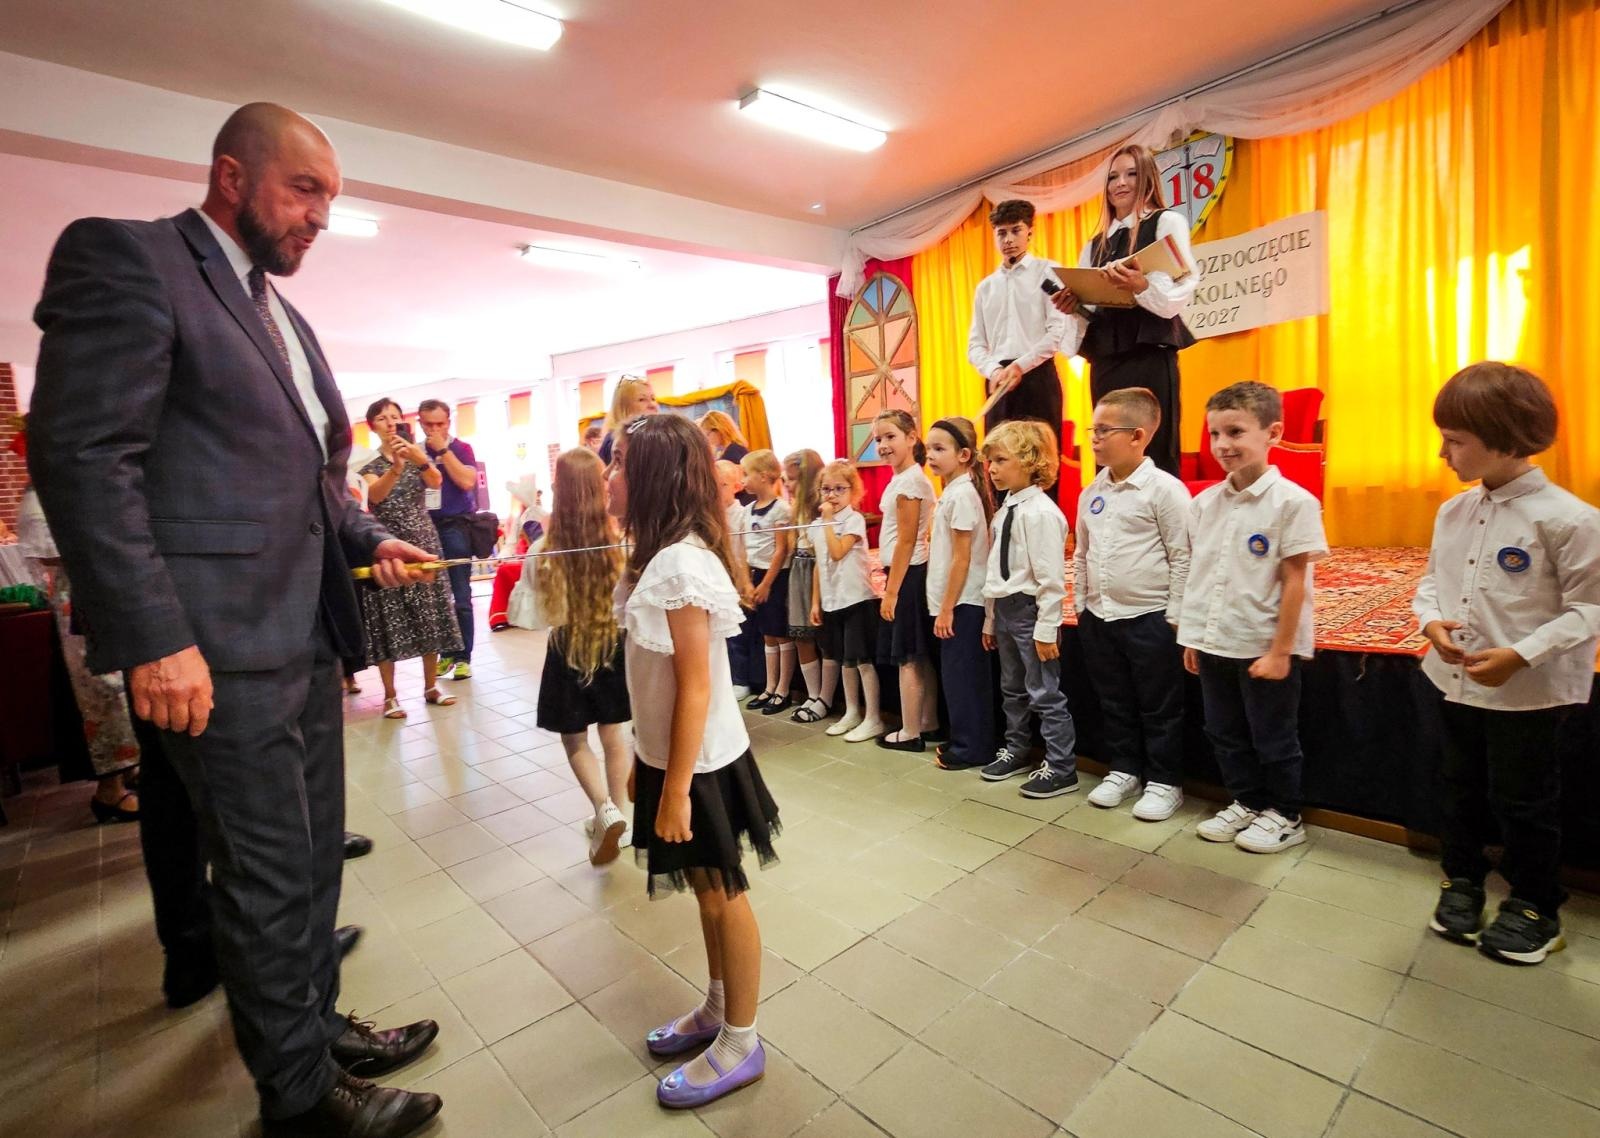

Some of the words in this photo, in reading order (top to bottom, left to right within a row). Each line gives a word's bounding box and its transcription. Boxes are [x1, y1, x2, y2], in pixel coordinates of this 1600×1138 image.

[1167, 163, 1215, 208] 18
[1196, 229, 1312, 281] OZPOCZĘCIE
[1187, 267, 1288, 306] KOLNEGO
